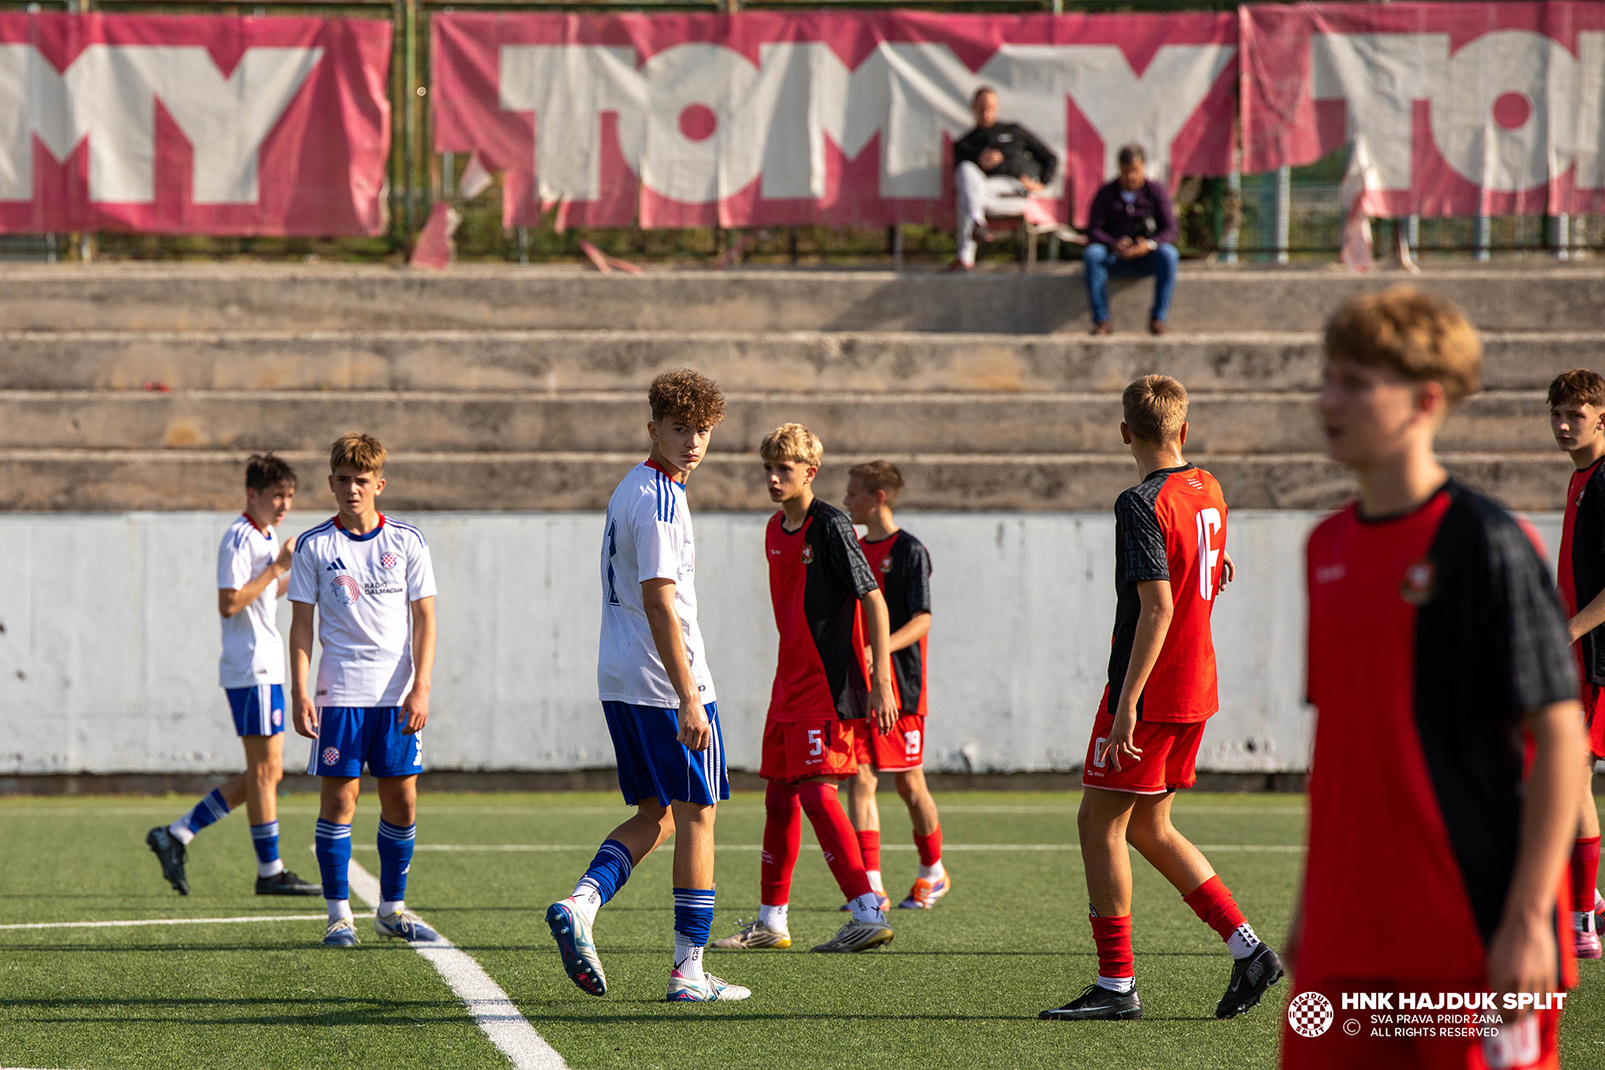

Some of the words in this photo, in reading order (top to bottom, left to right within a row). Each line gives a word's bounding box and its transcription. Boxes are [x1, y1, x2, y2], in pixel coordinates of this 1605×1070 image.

[499, 42, 1239, 199] TOMMY
[1311, 29, 1605, 192] TO
[364, 581, 387, 589] RADIO
[808, 729, 822, 756] 5
